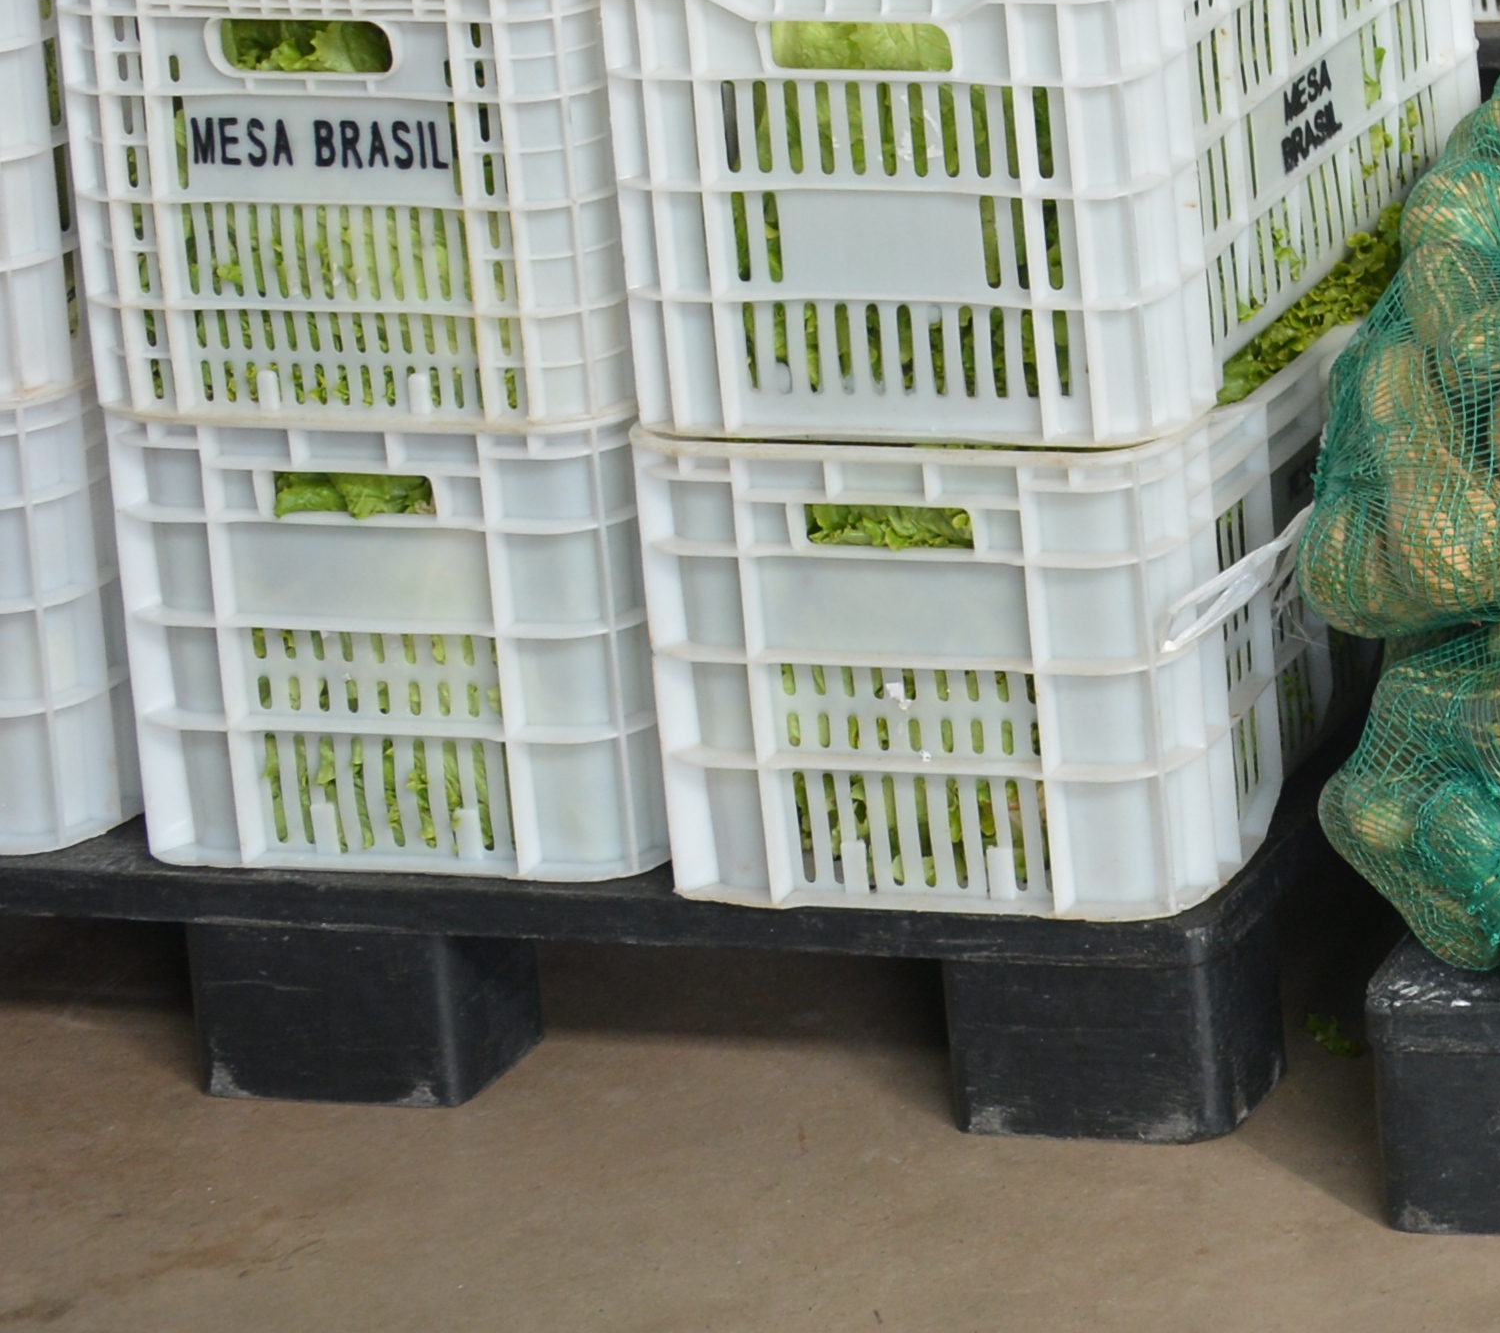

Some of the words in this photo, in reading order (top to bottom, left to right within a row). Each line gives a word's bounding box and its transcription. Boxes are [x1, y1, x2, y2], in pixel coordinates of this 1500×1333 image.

[1283, 59, 1333, 123] MESA
[189, 116, 294, 168] MESA
[313, 118, 450, 171] BRASIL
[1280, 102, 1343, 176] BRASIL
